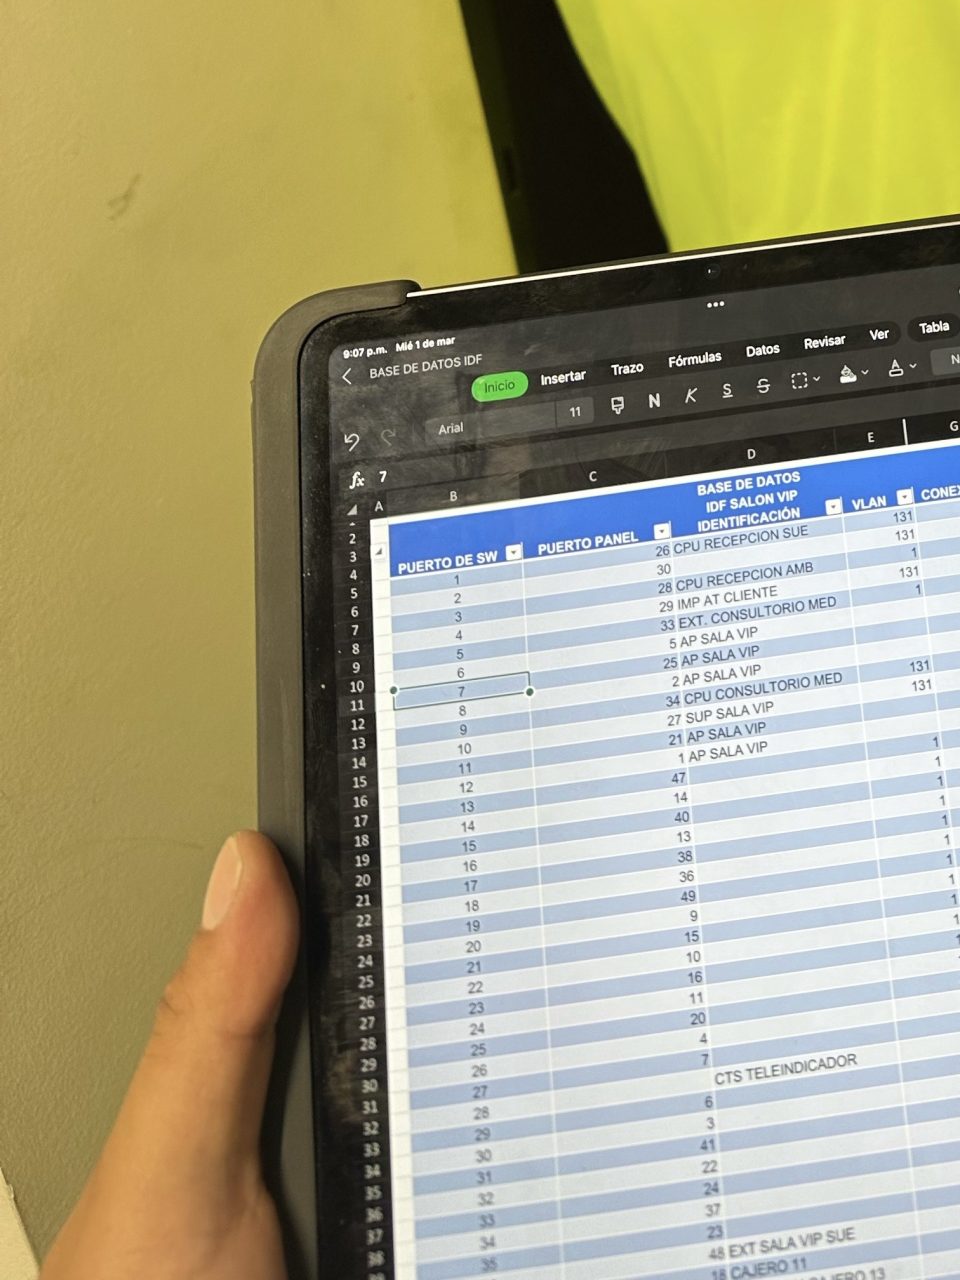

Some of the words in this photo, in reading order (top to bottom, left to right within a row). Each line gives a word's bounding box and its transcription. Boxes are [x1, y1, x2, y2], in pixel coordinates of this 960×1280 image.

[918, 320, 950, 334] Tabla
[869, 329, 889, 340] Ver
[395, 340, 413, 351] Mié
[422, 338, 434, 348] de
[436, 336, 455, 346] mar
[803, 335, 846, 349] Revisar
[342, 347, 364, 359] 9:07
[366, 346, 387, 357] p.m.
[746, 344, 780, 357] Datos
[369, 364, 399, 378] BASE
[403, 362, 418, 374] DE
[422, 356, 461, 372] DATOS
[464, 353, 482, 366] IDF
[668, 351, 722, 368] Fórmulas
[610, 363, 644, 375] Trazo
[540, 370, 586, 385] Insertar
[484, 379, 515, 393] Inicio
[569, 406, 580, 417] 11
[438, 421, 463, 435] Arial
[697, 480, 732, 496] BASE
[735, 477, 753, 490] DE
[756, 471, 800, 487] DATOS
[706, 499, 726, 513] IDF
[729, 492, 774, 509] SALON
[776, 489, 797, 502] VIP
[852, 495, 886, 510] VLAN
[697, 506, 800, 532] IDENTIFICACIÓN
[893, 510, 912, 522] 131
[538, 537, 591, 555] PUERTO
[594, 531, 638, 547] PANEL
[673, 540, 700, 554] CPU
[704, 529, 779, 550] RECEPCION
[782, 524, 808, 539] SUE
[655, 544, 670, 557] 26
[398, 557, 452, 574] PUERTO
[455, 553, 473, 566] DE
[476, 550, 497, 563] SW
[676, 577, 703, 591] CPU
[706, 565, 782, 587] RECEPCION
[785, 561, 813, 575] AMB
[899, 565, 918, 577] 131
[657, 581, 672, 594] 28
[677, 596, 700, 610] IMP
[703, 593, 720, 606] AT
[723, 585, 777, 603] CLIENTE
[659, 600, 674, 613] 29
[678, 614, 709, 629] EXT.
[710, 600, 805, 624] CONSULTORIO
[808, 595, 836, 610] MED
[660, 619, 675, 631] 33
[680, 634, 697, 647] AP
[700, 629, 734, 645] SALA
[736, 626, 758, 639] VIP
[663, 656, 677, 669] 25
[681, 653, 698, 666] AP
[702, 648, 736, 663] SALA
[738, 645, 760, 658] VIP
[909, 659, 929, 672] 131
[682, 672, 700, 685] AP
[703, 667, 737, 682] SALA
[739, 663, 761, 677] VIP
[350, 679, 364, 693] 10
[684, 690, 711, 704] CPU
[715, 676, 810, 700] CONSULTORIO
[813, 671, 842, 686] MED
[911, 678, 931, 691] 131
[665, 695, 680, 707] 34
[685, 709, 712, 724] SUP
[716, 704, 750, 719] SALA
[752, 700, 774, 714] VIP
[667, 713, 681, 726] 27
[687, 730, 705, 743] AP
[708, 725, 742, 740] SALA
[744, 721, 766, 734] VIP
[668, 733, 682, 746] 21
[457, 742, 472, 754] 10
[688, 749, 706, 762] AP
[709, 744, 744, 760] SALA
[746, 740, 768, 754] VIP
[352, 775, 367, 789] 15
[671, 771, 686, 783] 47
[460, 800, 475, 813] 13
[674, 810, 689, 822] 40
[463, 859, 477, 872] 16
[354, 873, 371, 887] 20
[465, 939, 481, 953] 20
[690, 1011, 706, 1025] 20
[469, 1022, 485, 1036] 24
[714, 1069, 742, 1085] CTS
[745, 1053, 857, 1080] TELEINDICADOR
[473, 1105, 489, 1120] 28
[728, 1241, 756, 1258] EXT
[759, 1236, 795, 1254] SALA
[799, 1231, 823, 1247] VIP
[826, 1226, 855, 1244] SUE
[730, 1259, 789, 1280] CAJERO
[792, 1256, 807, 1271] 11
